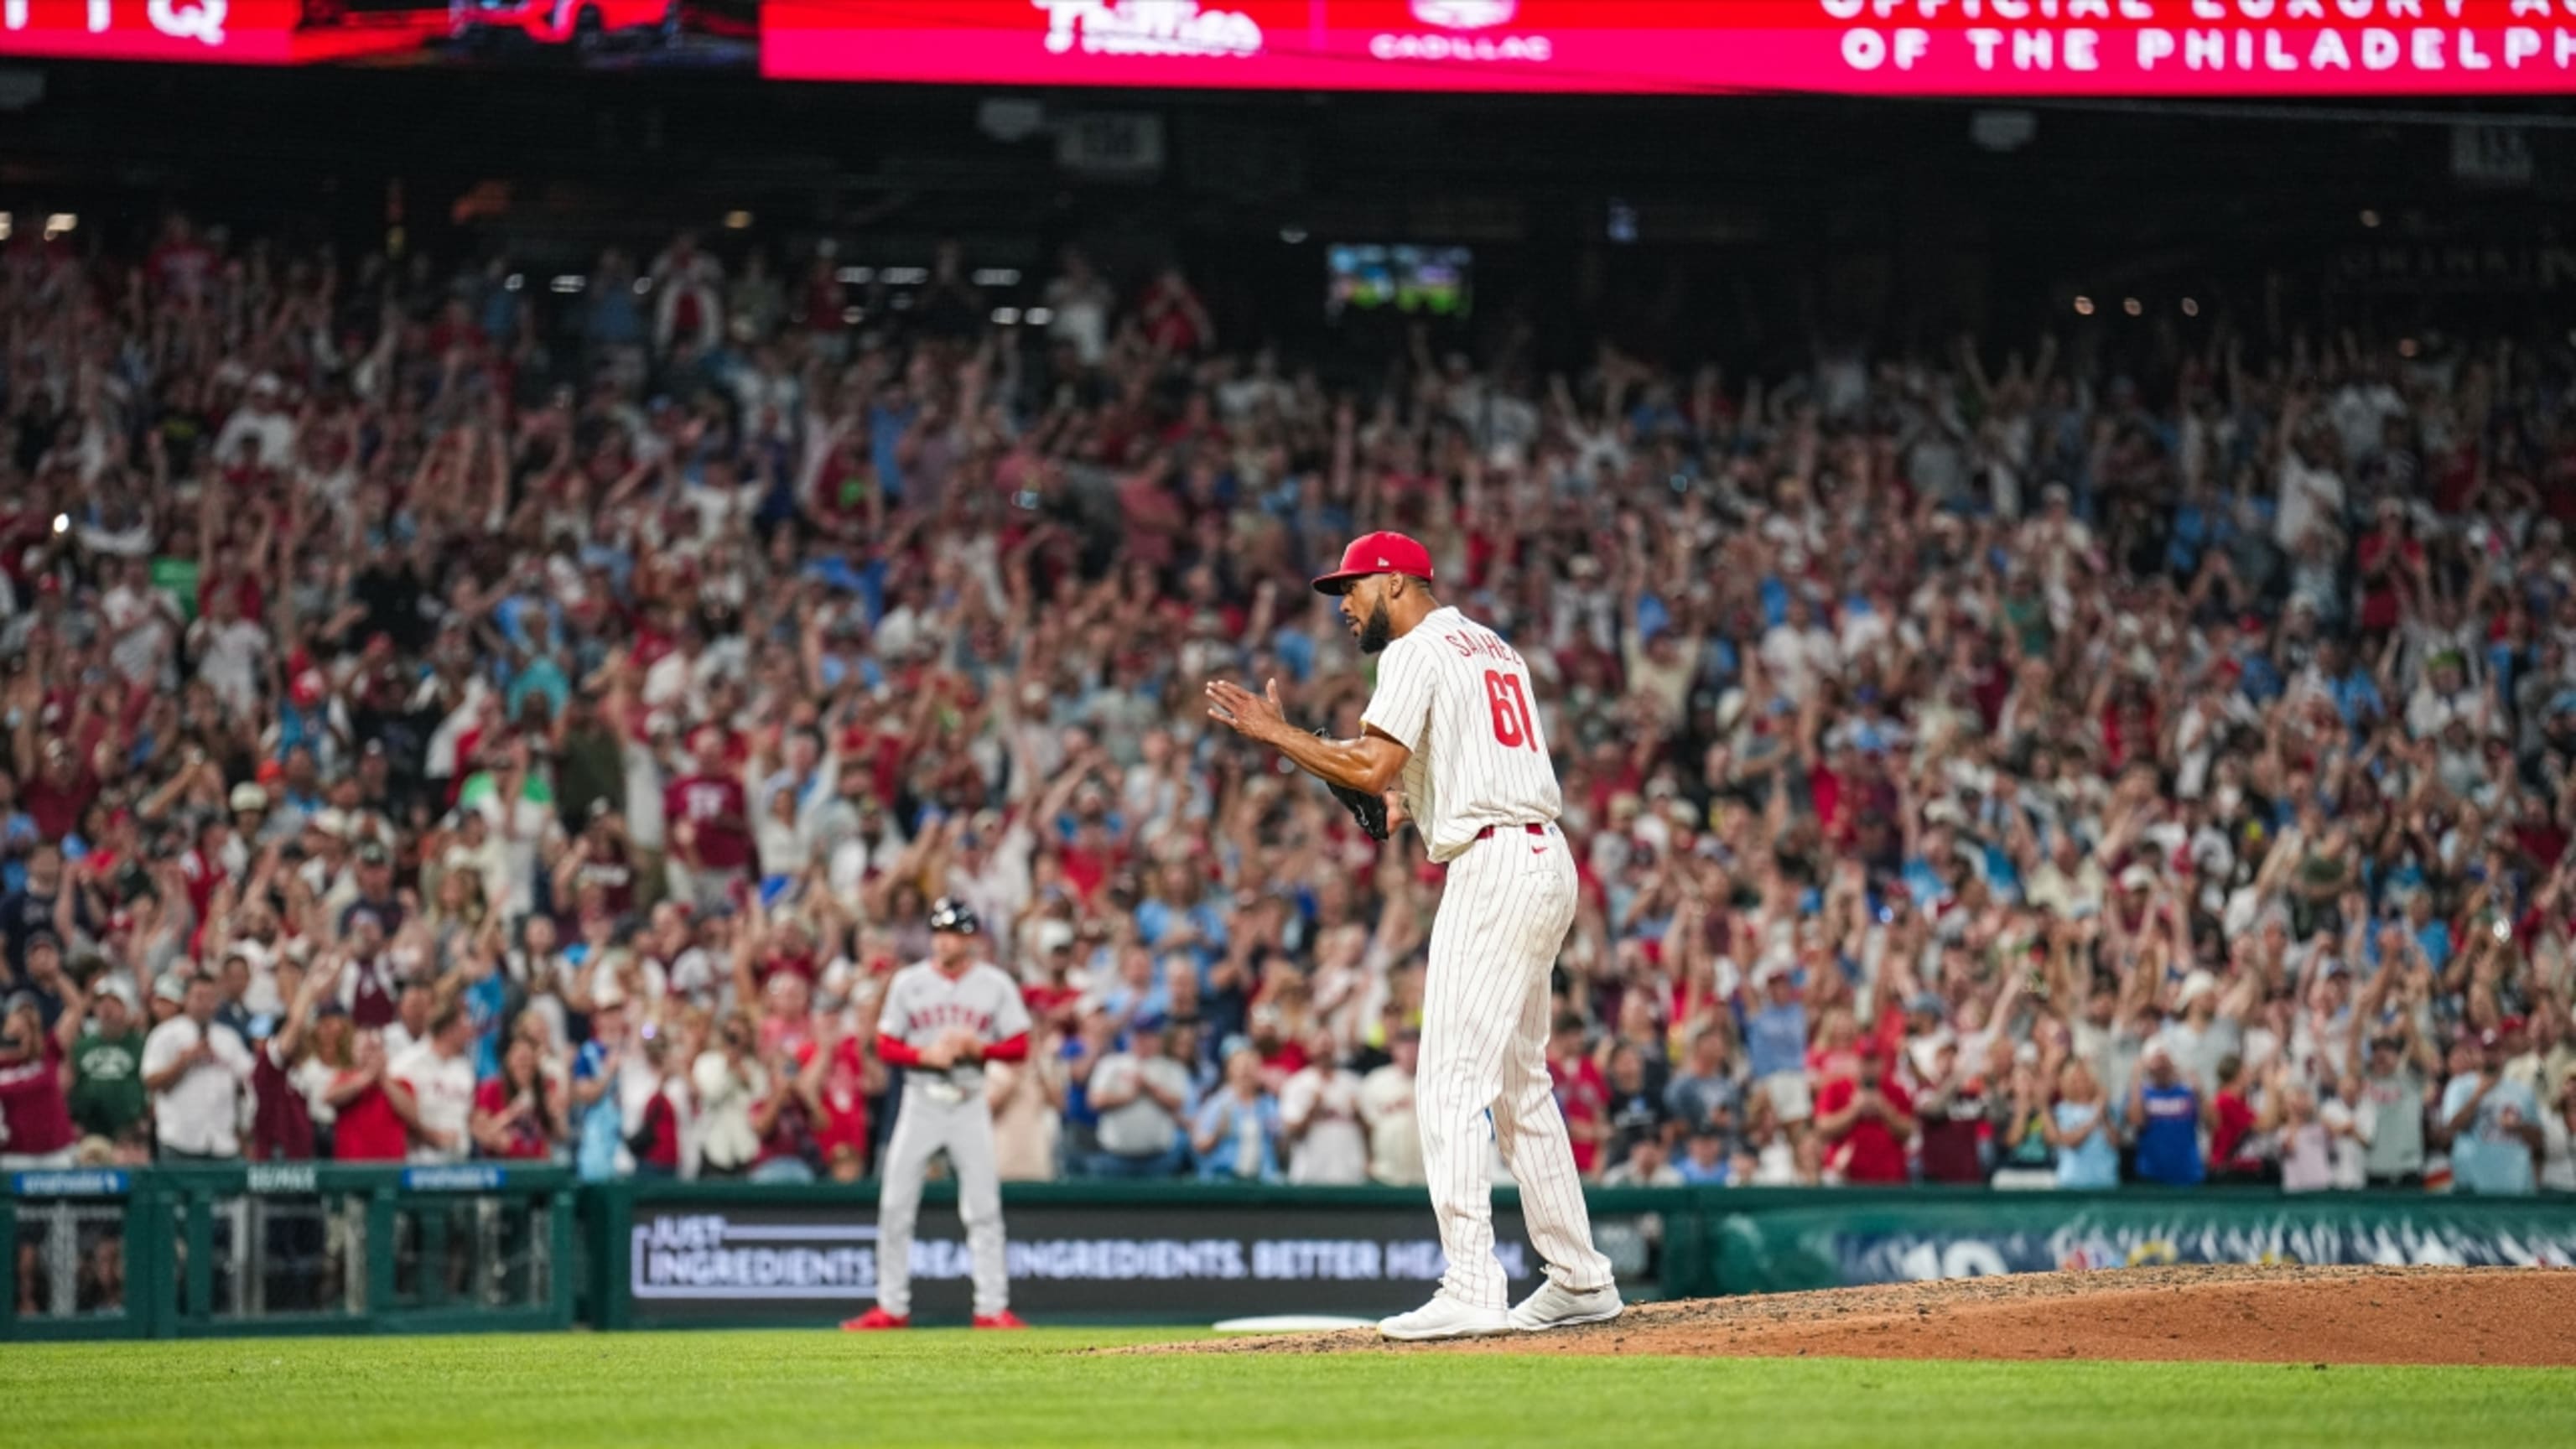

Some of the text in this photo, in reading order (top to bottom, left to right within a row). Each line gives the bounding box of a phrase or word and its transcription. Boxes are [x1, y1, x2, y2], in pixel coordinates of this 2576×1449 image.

[1841, 27, 2576, 70] OF THE PHILADELPH
[1484, 668, 1538, 752] 61
[649, 1215, 727, 1249] JUST
[649, 1248, 876, 1285] INGREDIENTS
[909, 1239, 974, 1279] REA
[1252, 1240, 1381, 1280] BETTER
